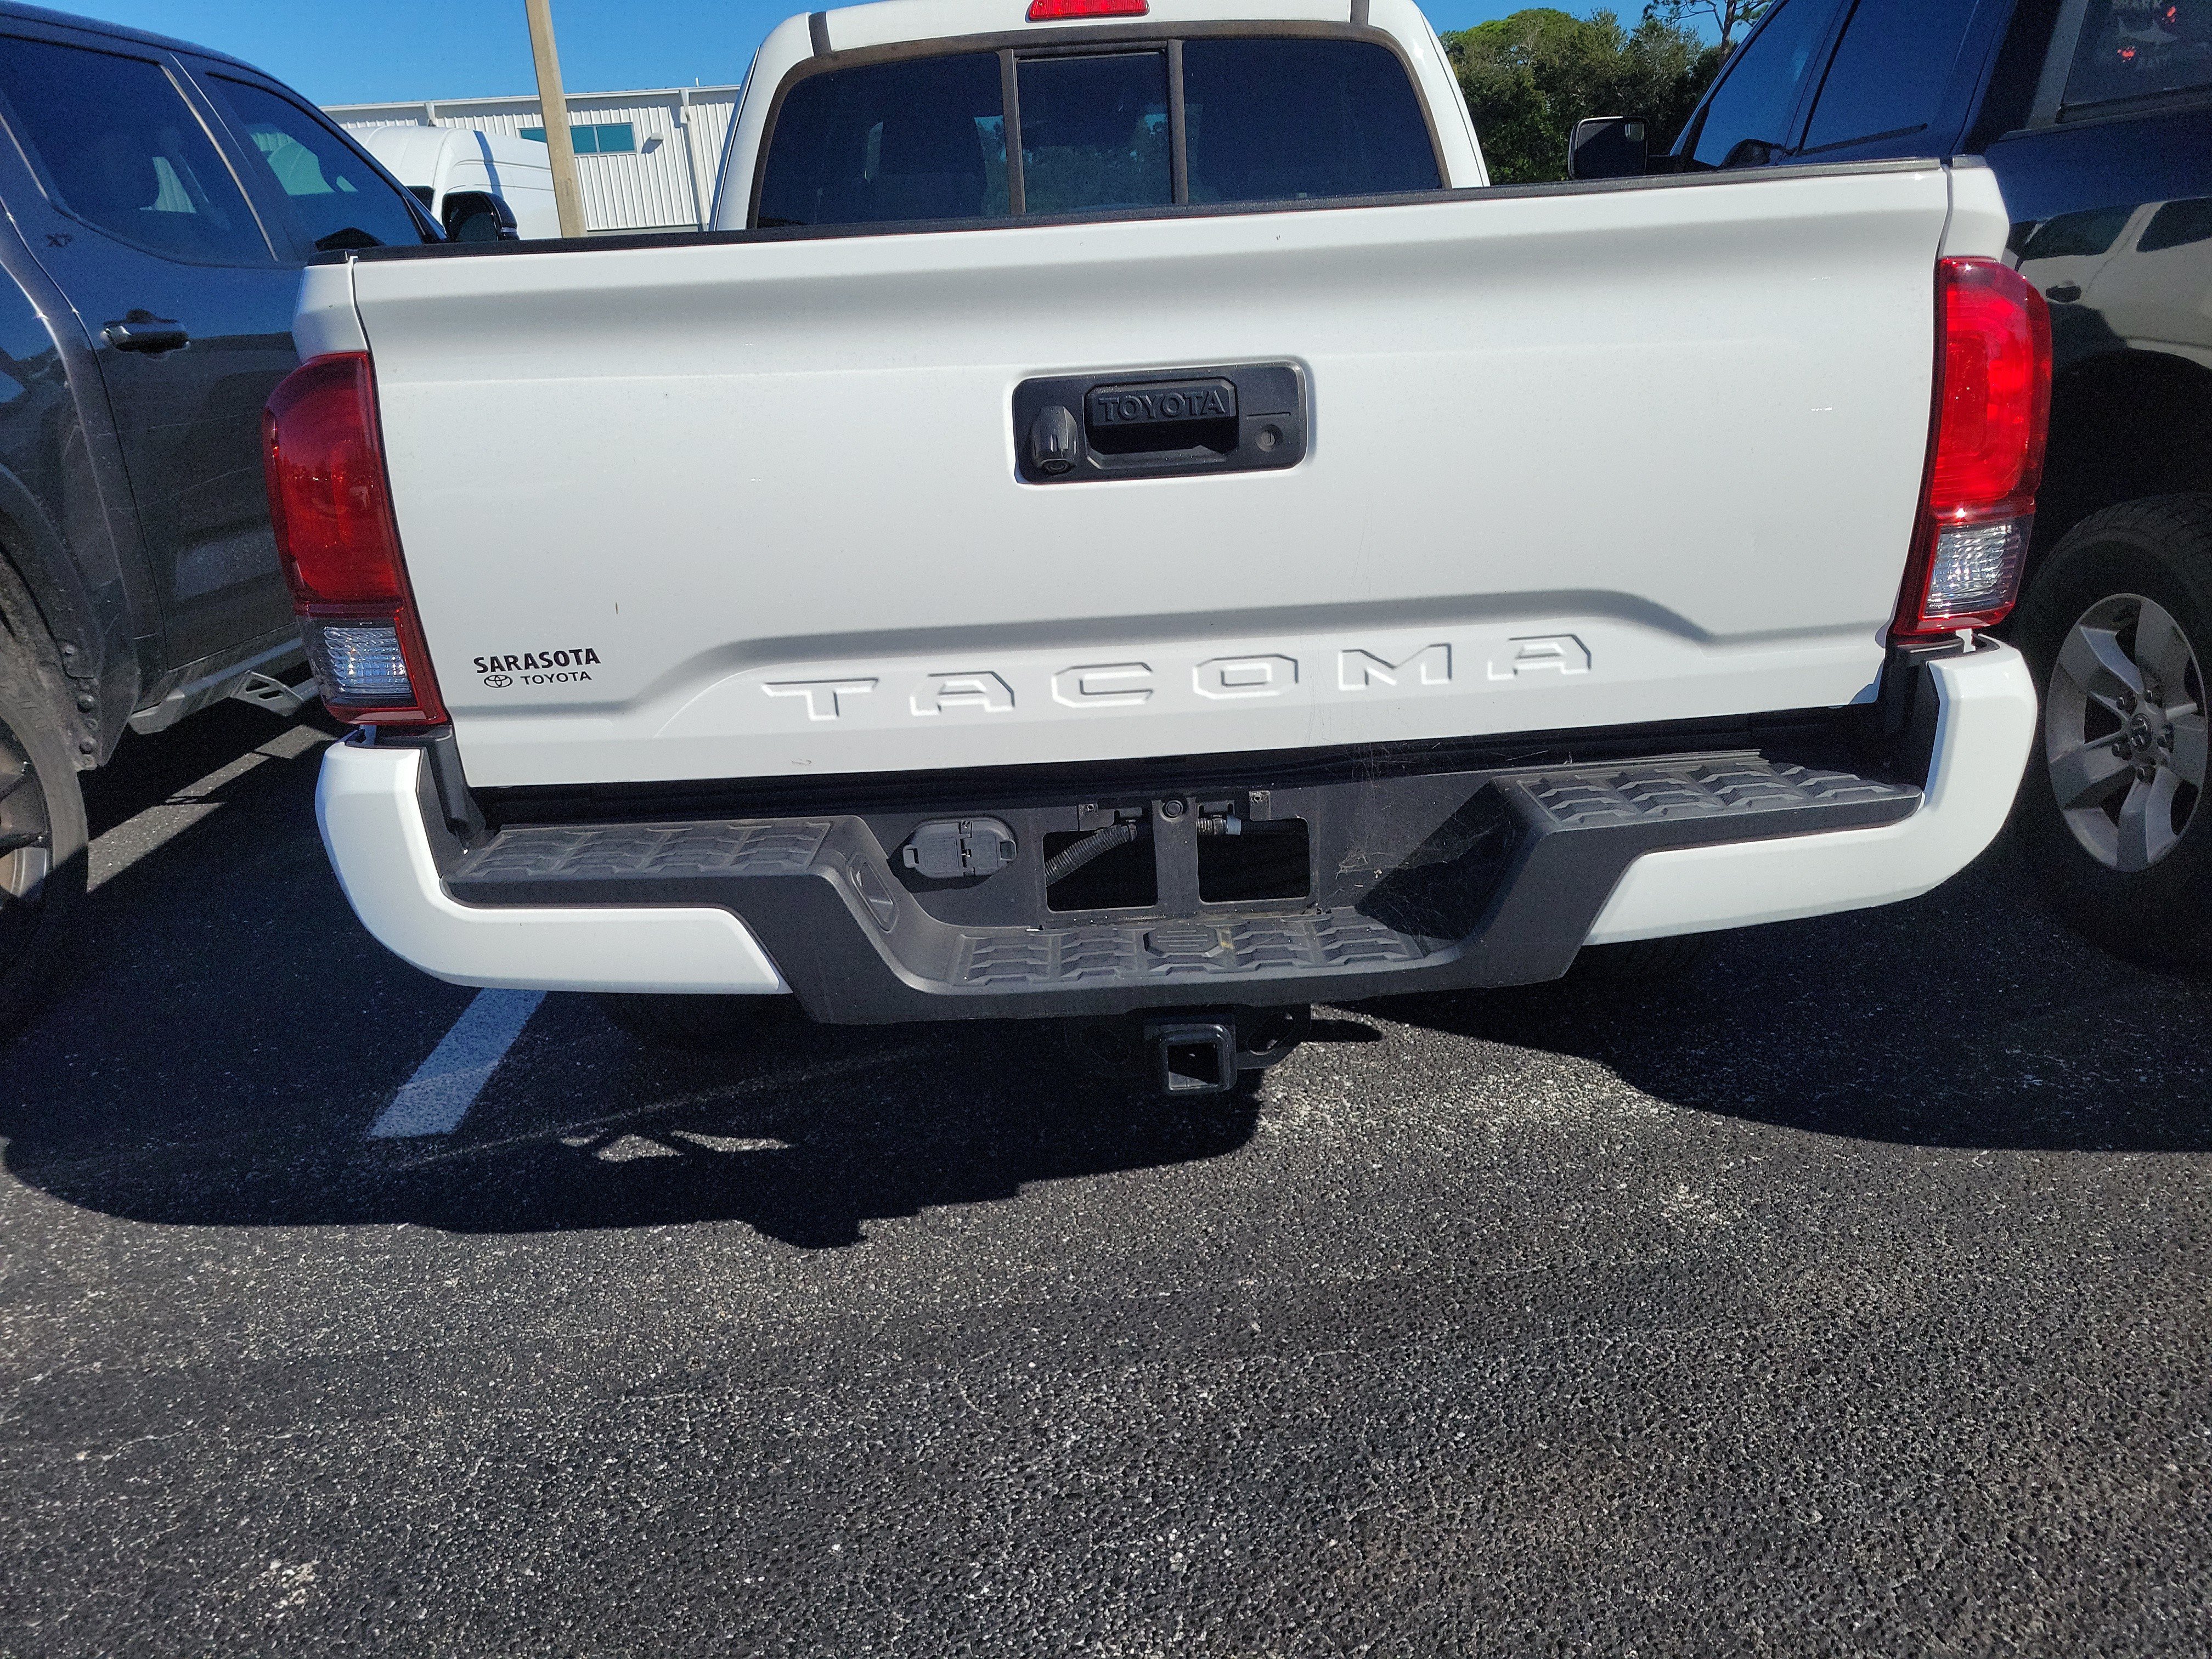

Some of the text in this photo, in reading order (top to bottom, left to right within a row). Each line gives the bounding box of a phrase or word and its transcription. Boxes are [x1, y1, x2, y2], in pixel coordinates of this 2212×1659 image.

[1098, 388, 1227, 422] TOYOTA
[473, 648, 601, 674] SARASOTA
[520, 671, 592, 685] TOYOTA
[761, 634, 1592, 721] TACOMA
